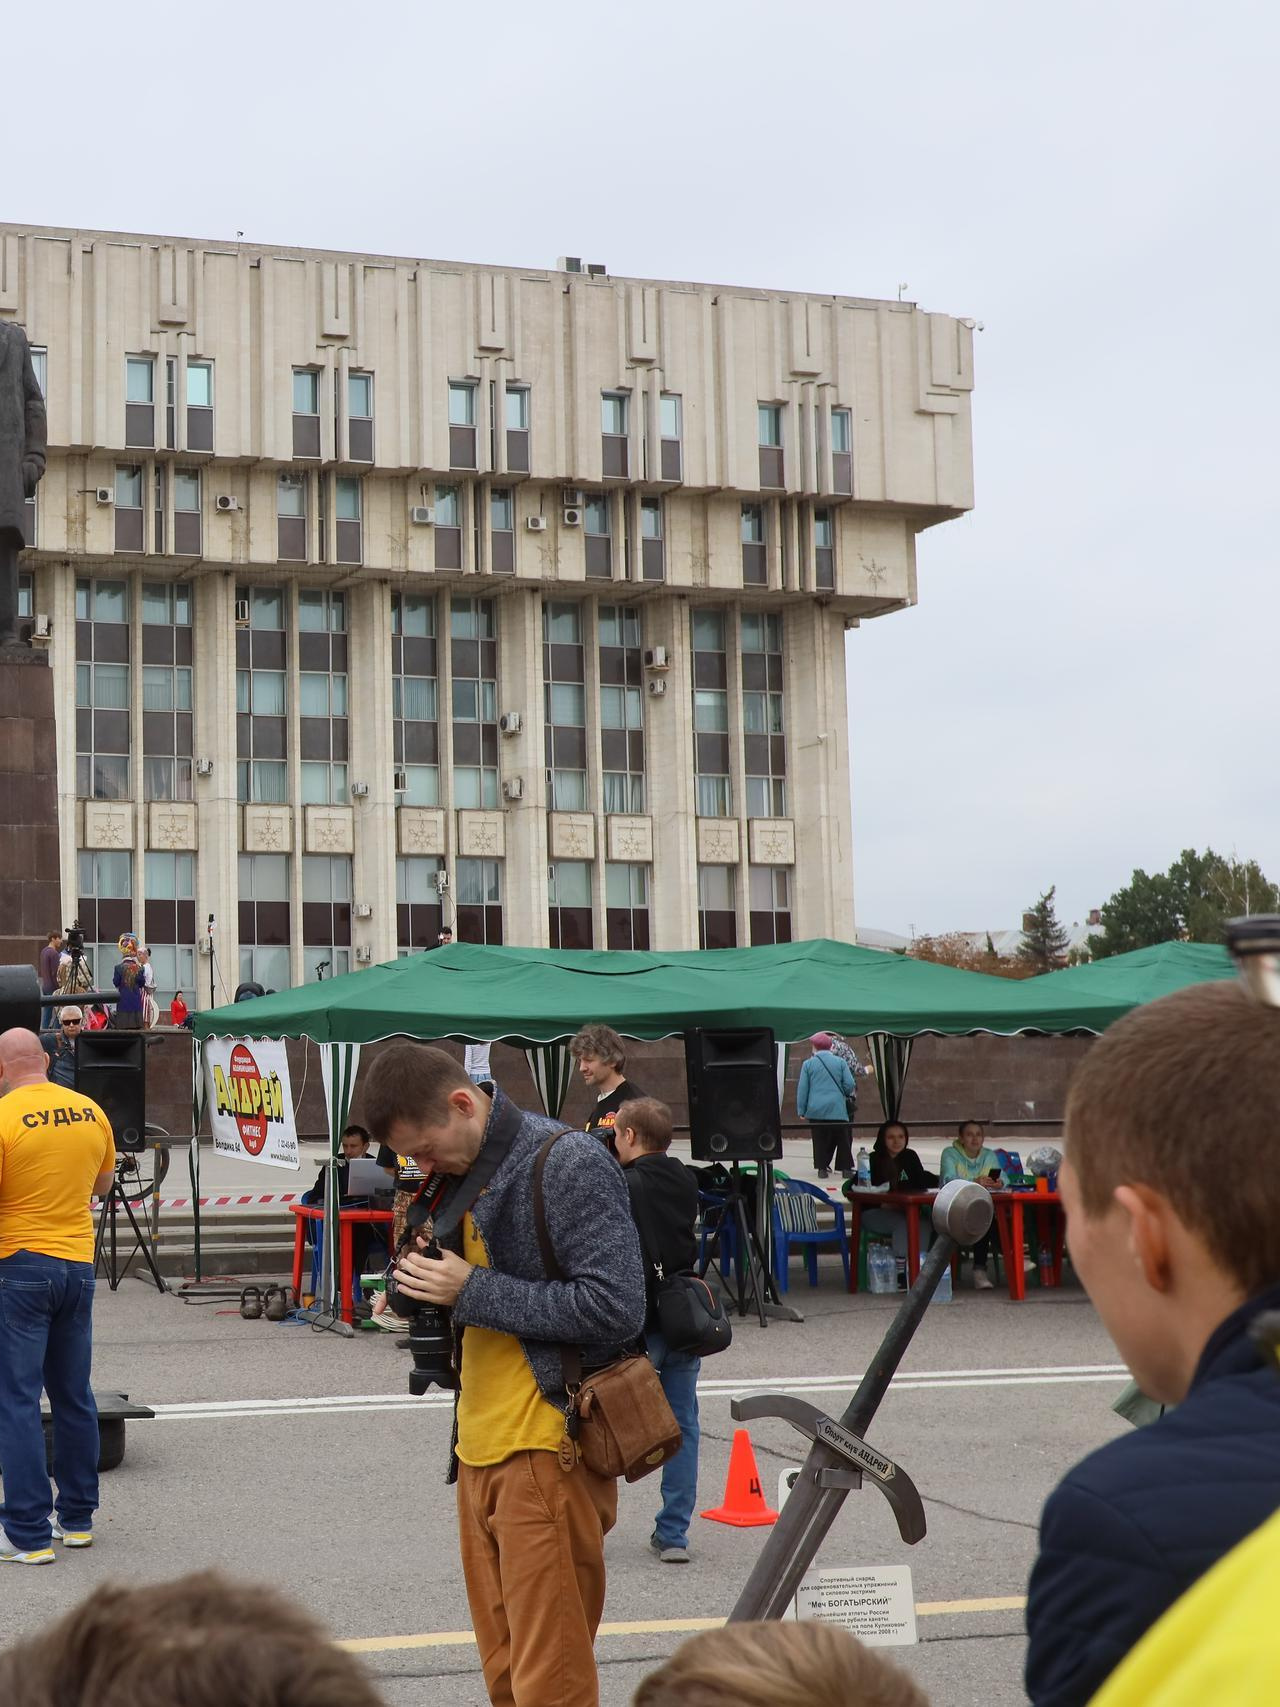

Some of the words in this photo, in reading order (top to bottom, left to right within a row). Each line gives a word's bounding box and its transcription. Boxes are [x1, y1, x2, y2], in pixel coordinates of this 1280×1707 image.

[22, 1107, 96, 1128] СУДЬЯ
[824, 1425, 844, 1441] Спорт
[750, 1477, 762, 1498] 4
